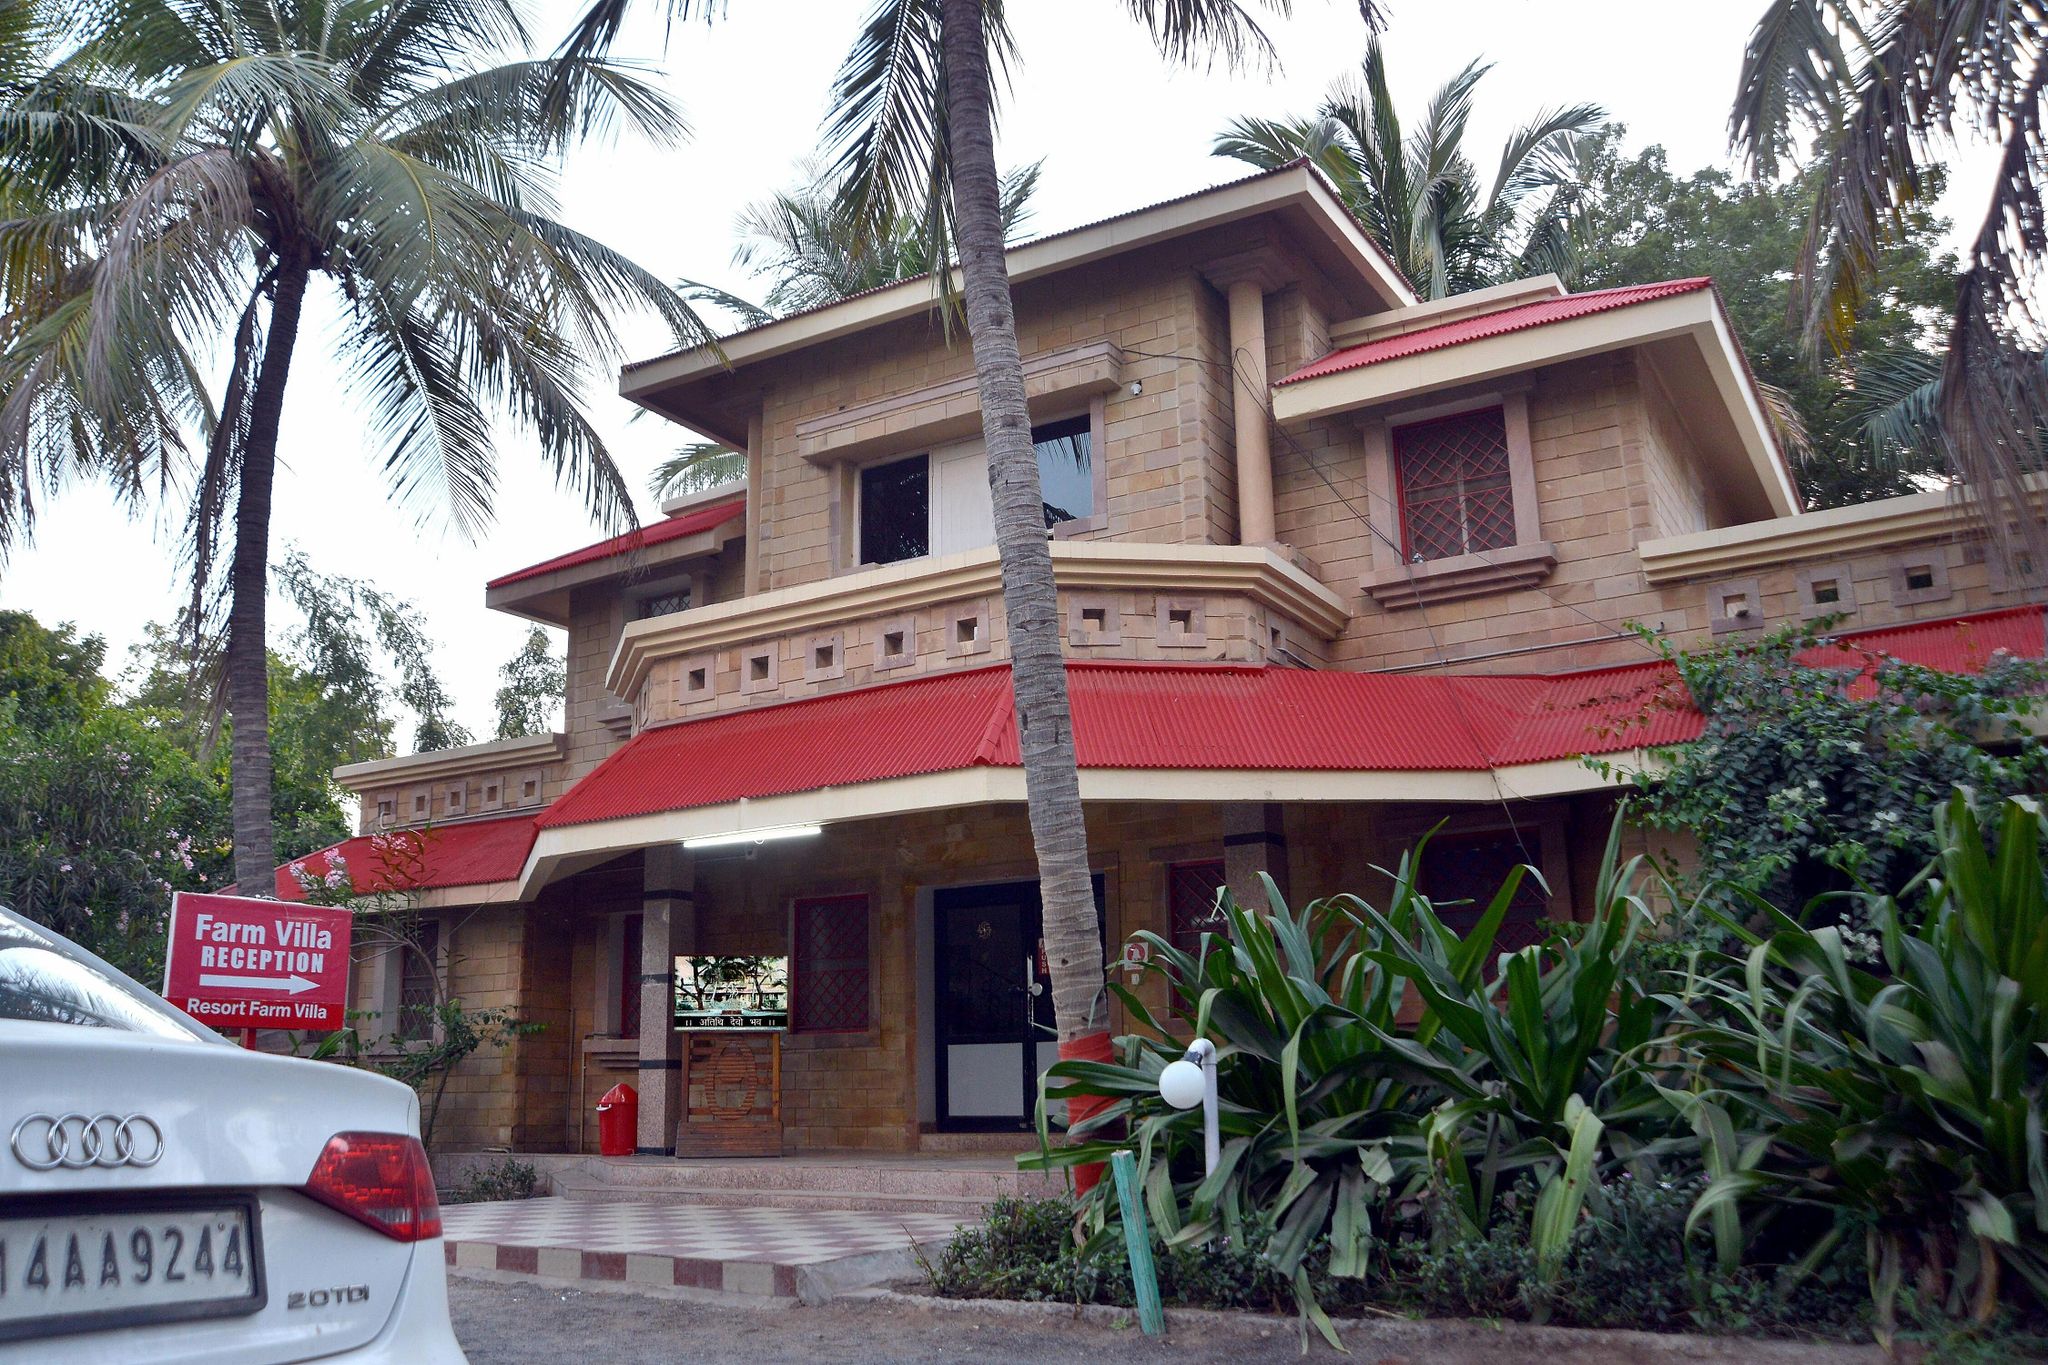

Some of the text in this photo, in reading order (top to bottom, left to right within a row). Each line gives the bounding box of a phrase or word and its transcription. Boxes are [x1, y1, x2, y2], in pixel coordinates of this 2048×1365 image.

[195, 913, 332, 950] Farm Villa
[201, 945, 325, 974] RECEPTION
[187, 997, 327, 1019] Resort Farm Villa
[699, 1016, 724, 1026] अतिथि
